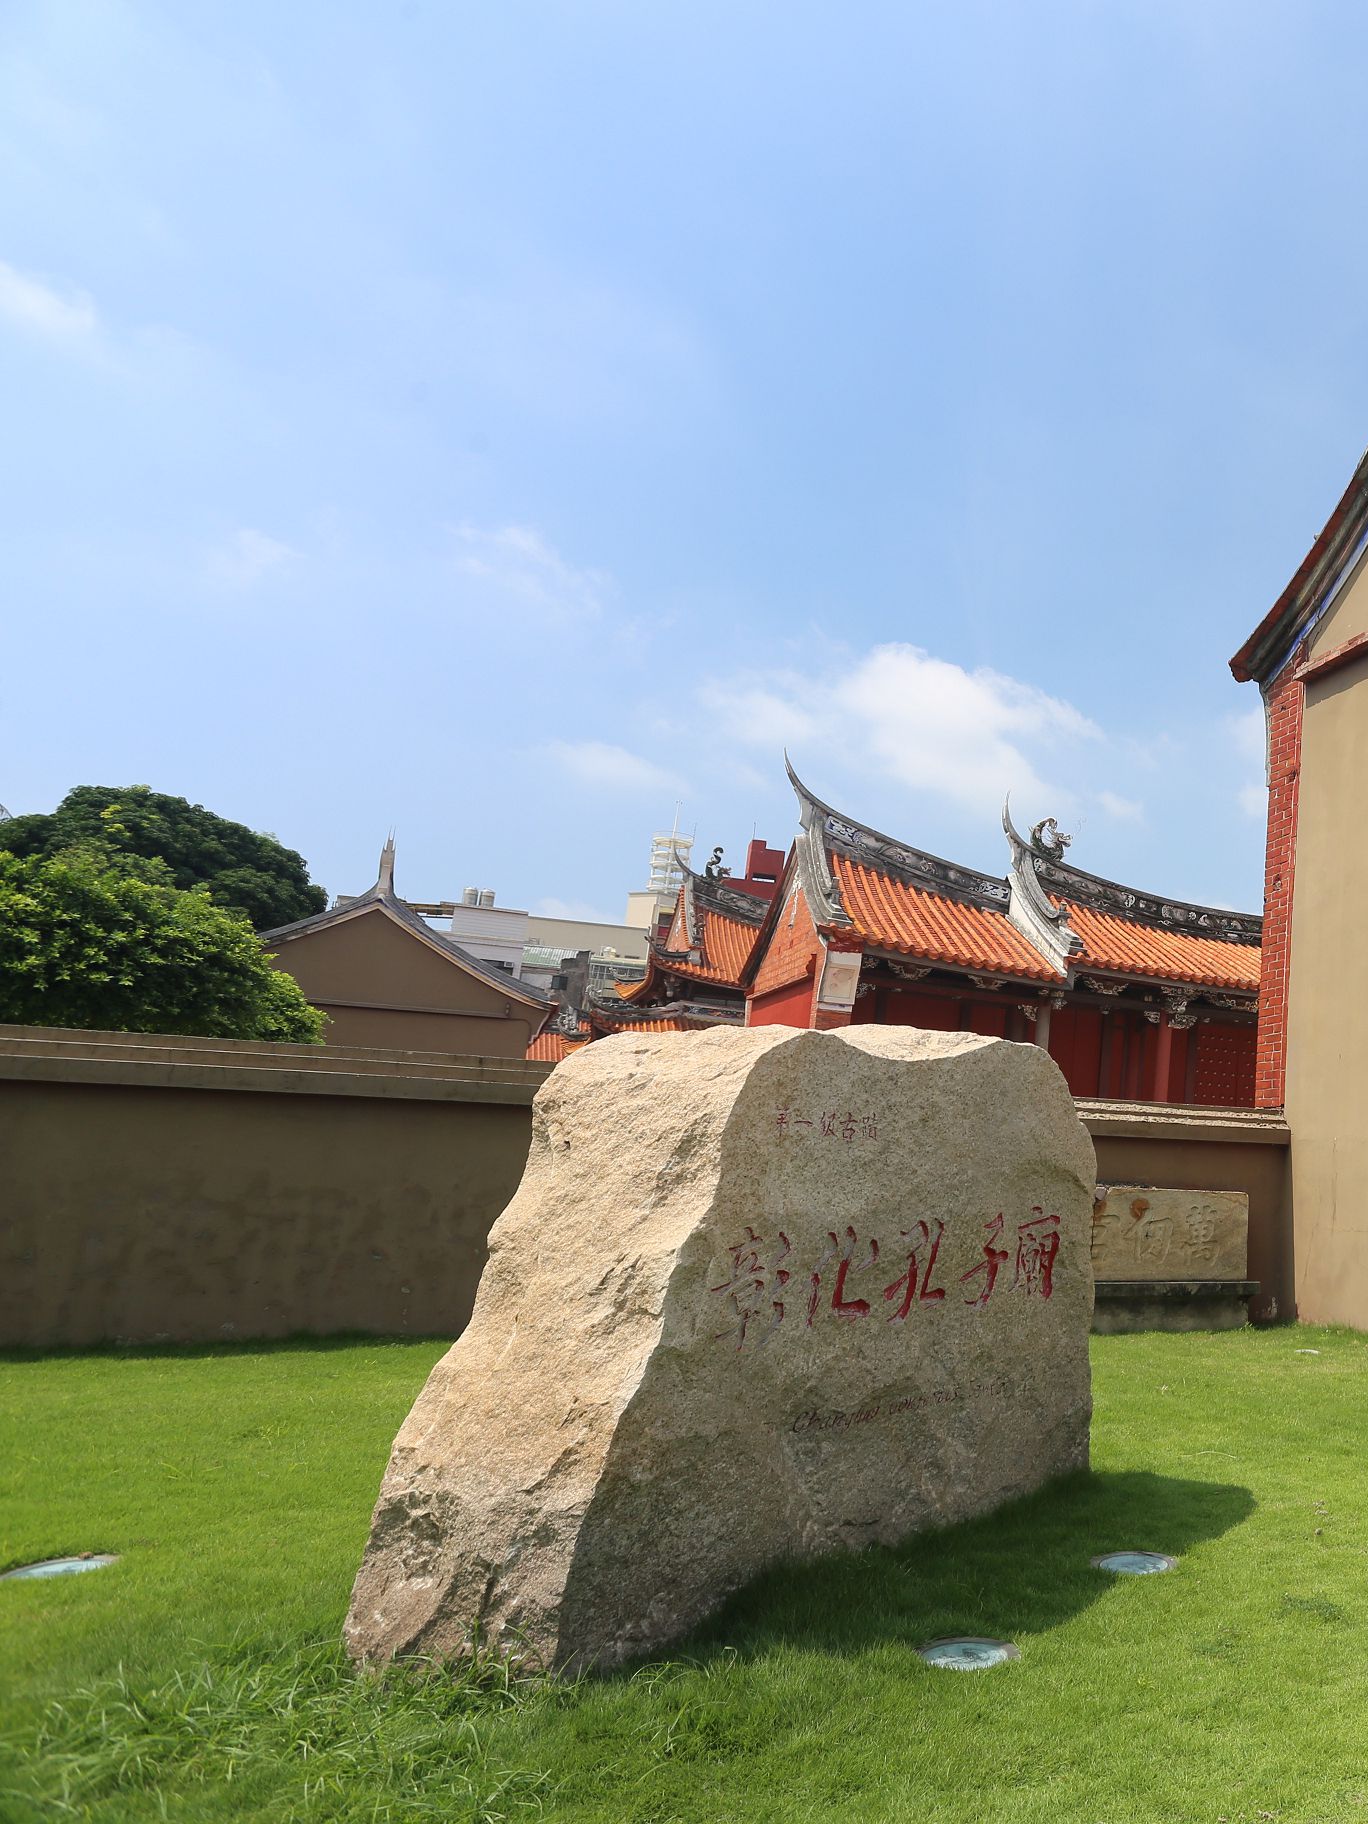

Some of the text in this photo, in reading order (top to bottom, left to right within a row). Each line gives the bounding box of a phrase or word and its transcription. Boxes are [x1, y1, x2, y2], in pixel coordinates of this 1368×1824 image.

[711, 1206, 1062, 1352] 彰化孔子廟
